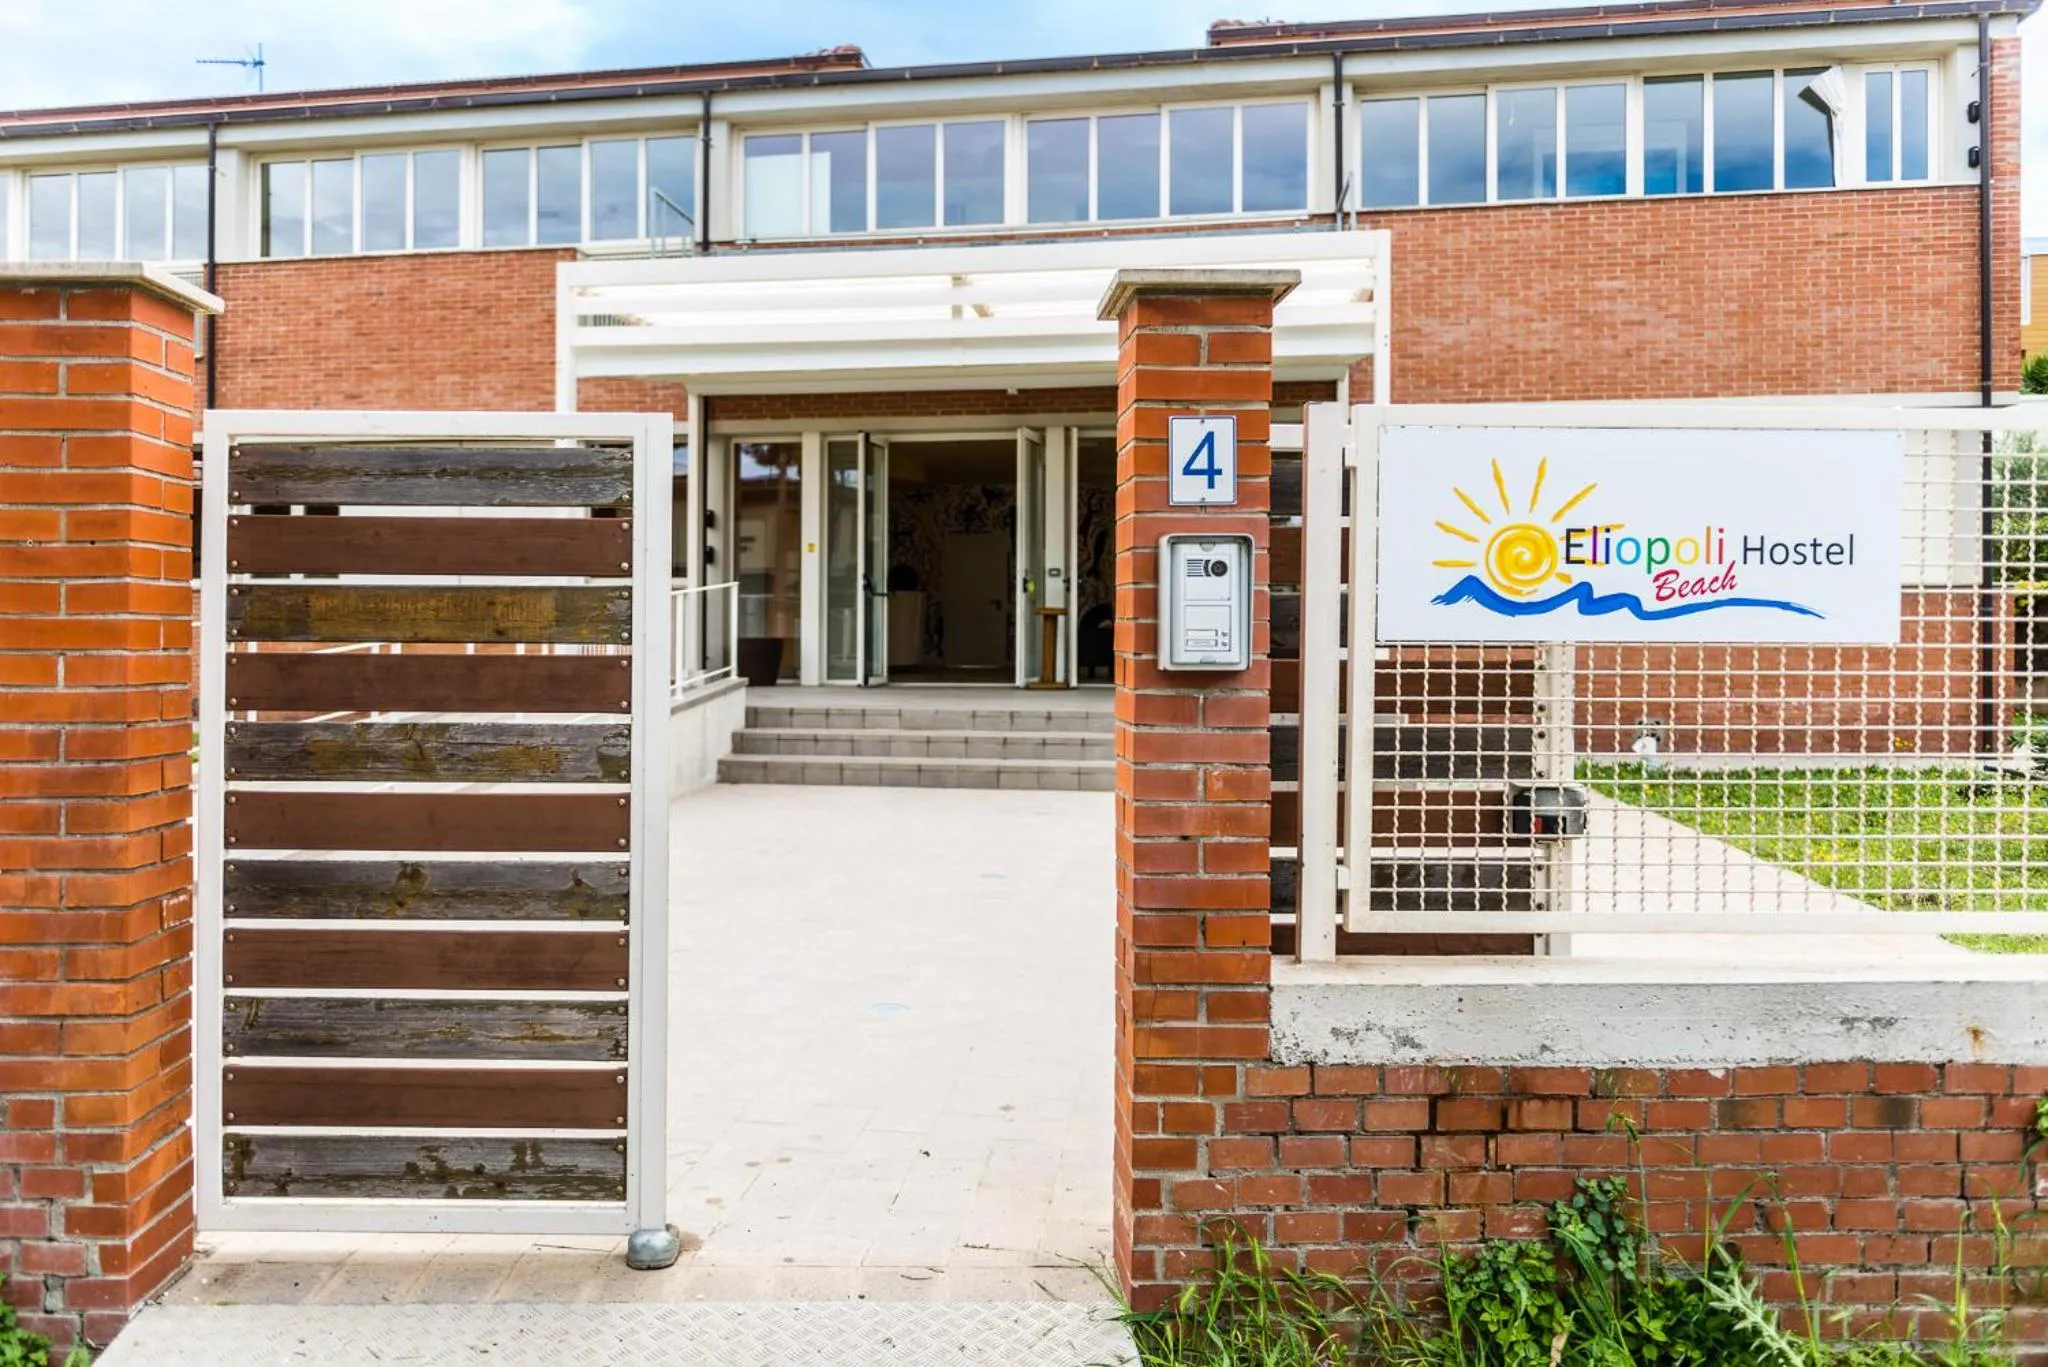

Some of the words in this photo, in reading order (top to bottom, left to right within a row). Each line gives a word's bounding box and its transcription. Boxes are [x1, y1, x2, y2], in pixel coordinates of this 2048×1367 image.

[1182, 430, 1223, 490] 4
[1564, 525, 1725, 574] Eliopoli
[1742, 533, 1855, 566] Hostel
[1652, 559, 1738, 602] Beach
